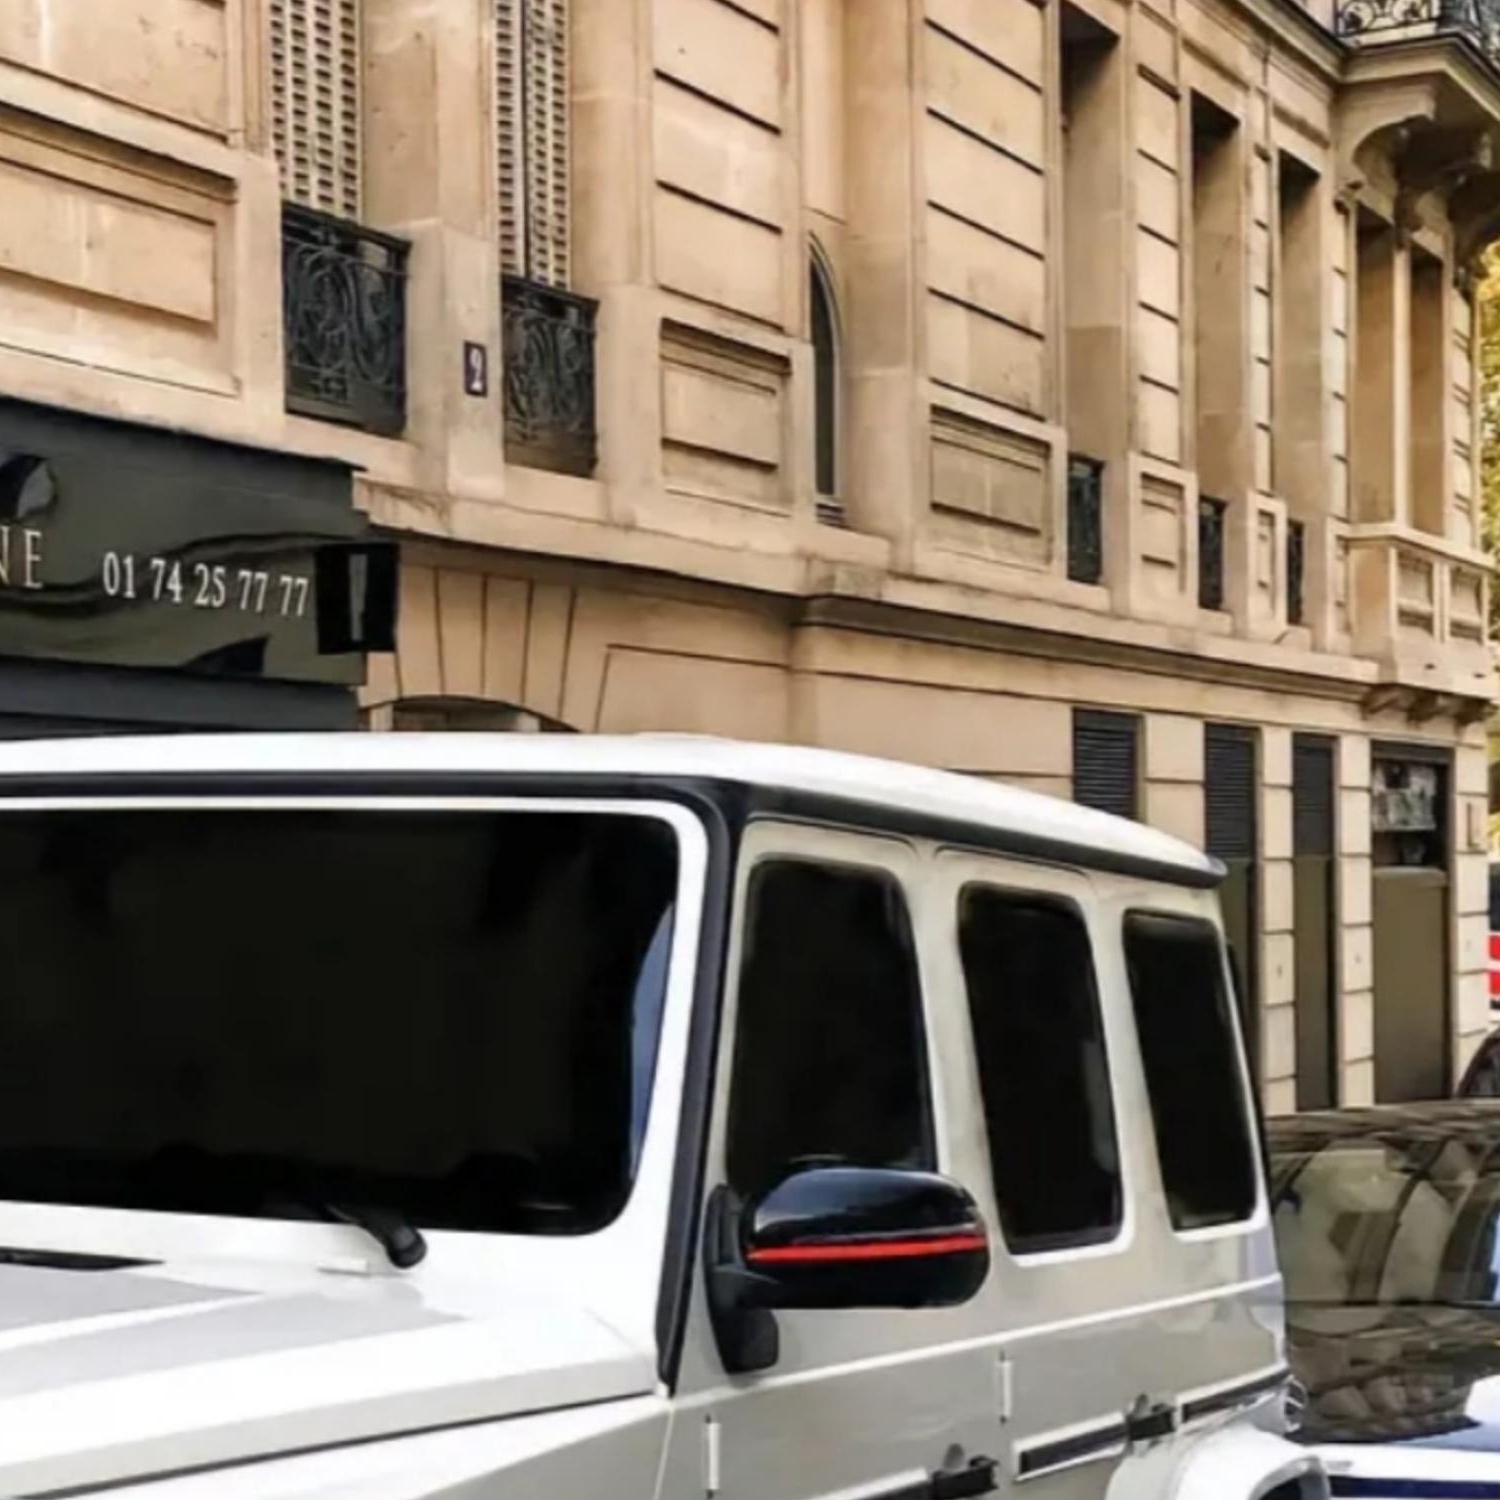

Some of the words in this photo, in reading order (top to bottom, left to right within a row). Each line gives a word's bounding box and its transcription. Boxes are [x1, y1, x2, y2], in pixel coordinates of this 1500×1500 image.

[103, 551, 136, 599] 01
[151, 558, 183, 603] 74
[194, 563, 226, 608] 25
[238, 569, 268, 613] 77
[279, 575, 308, 617] 77
